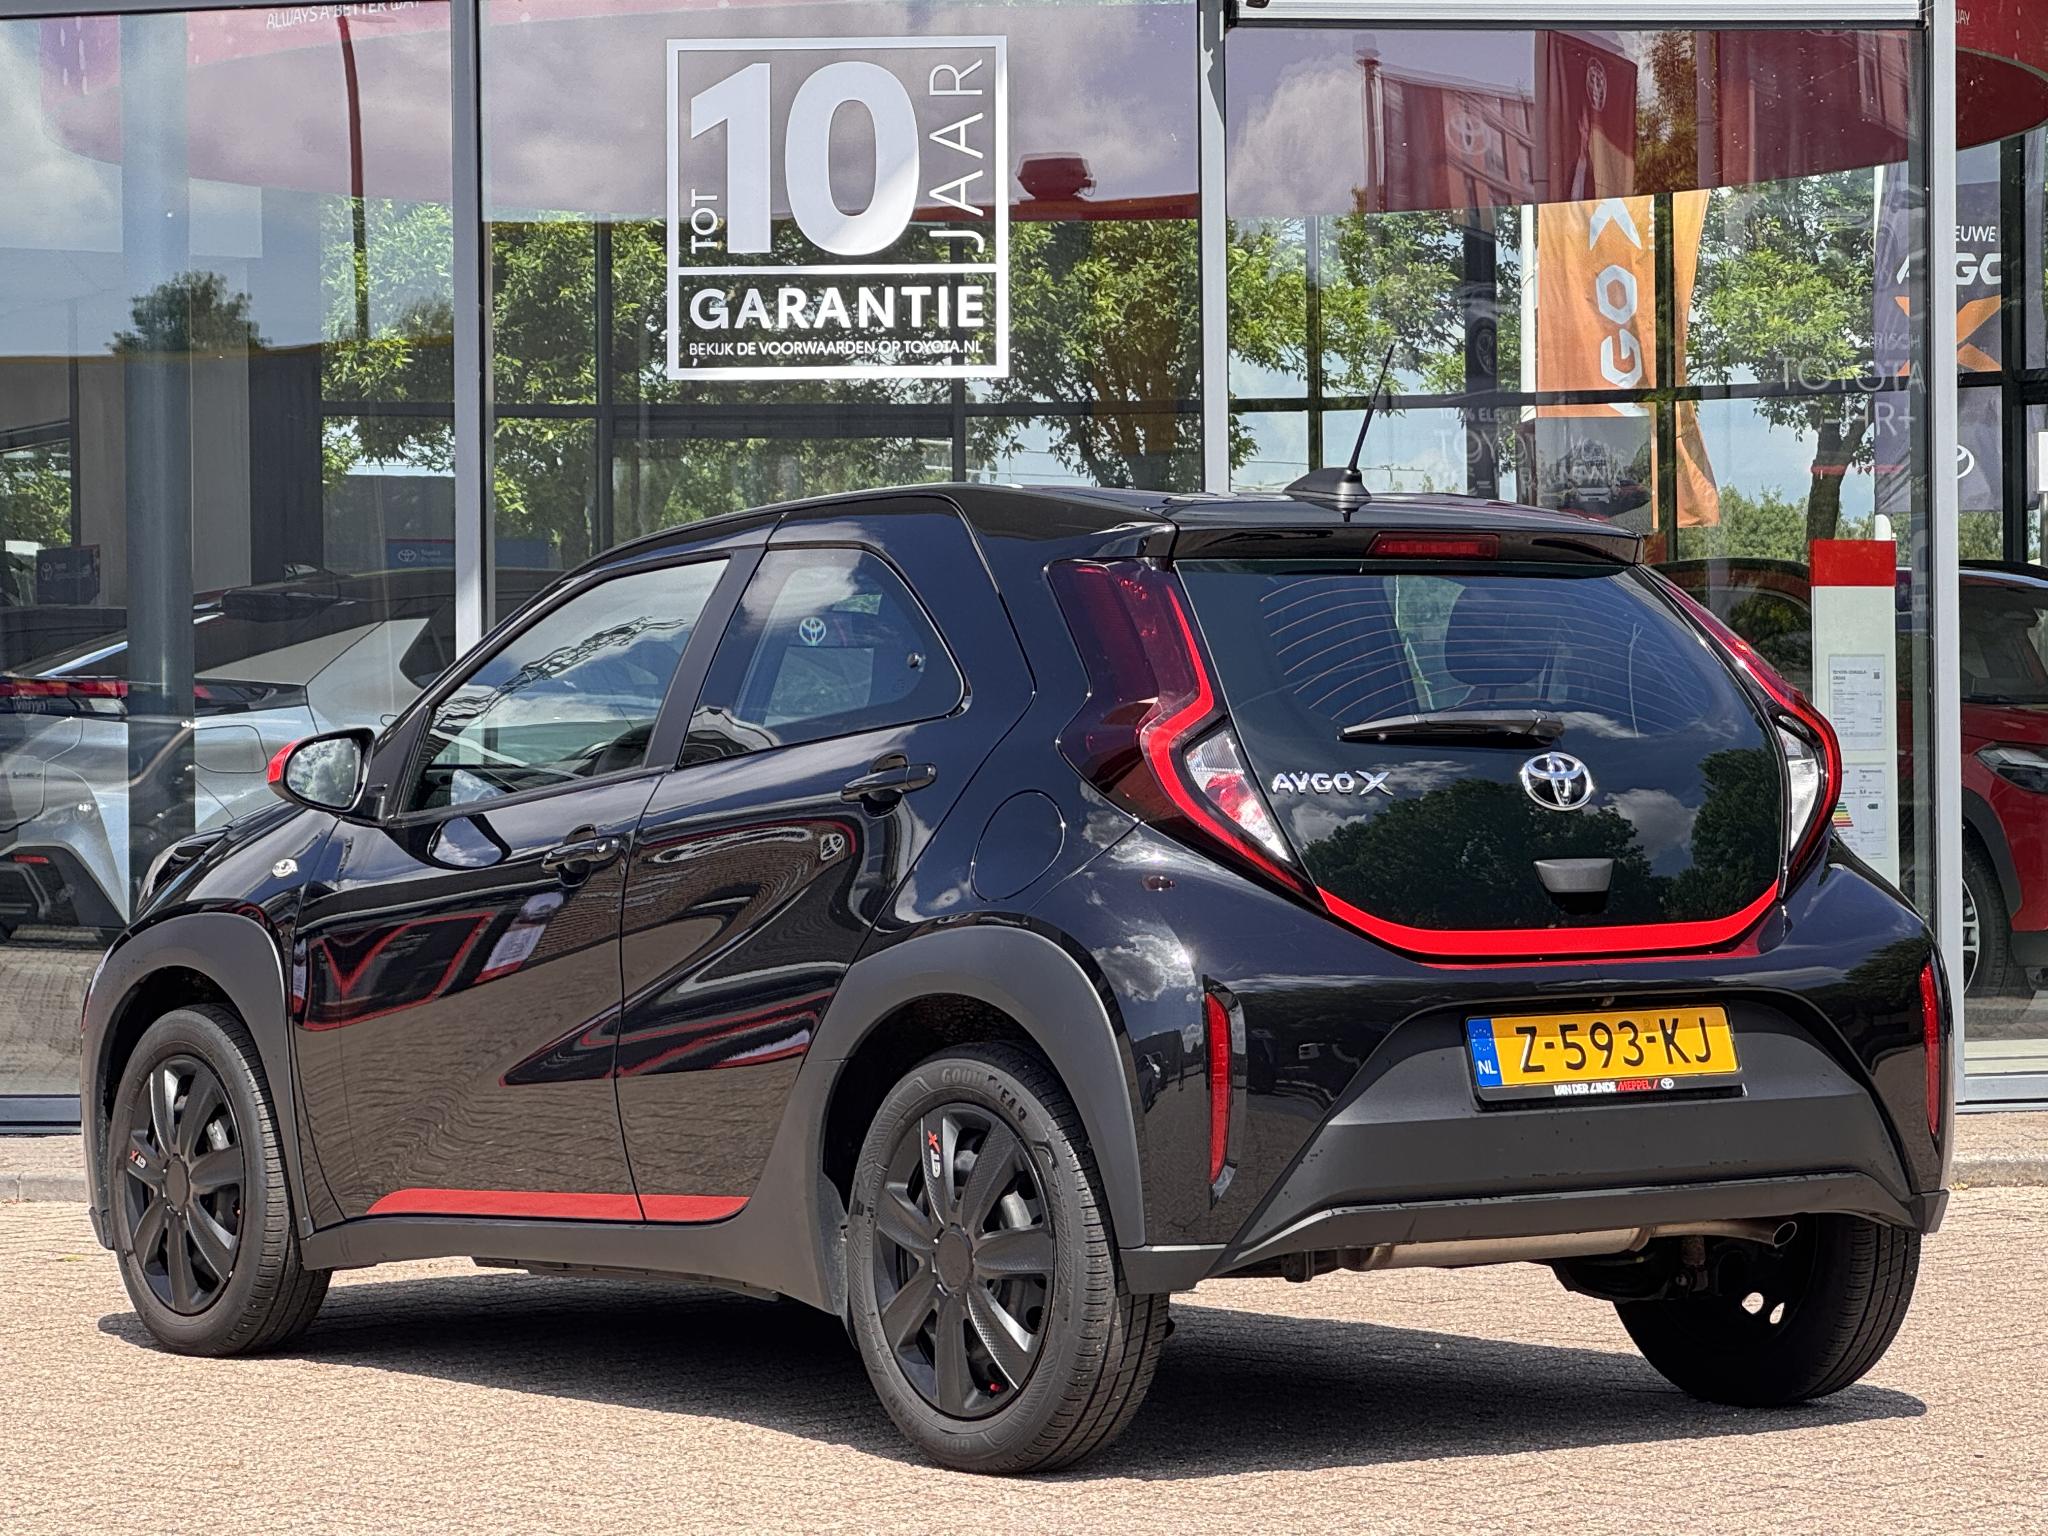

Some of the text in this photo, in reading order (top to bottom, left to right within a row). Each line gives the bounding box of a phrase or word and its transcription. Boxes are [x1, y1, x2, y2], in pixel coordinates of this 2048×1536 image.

[266, 7, 318, 30] ALWAYS
[319, 7, 331, 20] A
[690, 61, 920, 256] 10
[929, 58, 984, 253] JAAR
[691, 189, 718, 254] TOT
[689, 286, 984, 330] GARANTIE
[689, 339, 984, 356] BEKIJK DE VOORWAARDEN OP TOYOTA.NL
[1271, 772, 1355, 794] AYGO
[1515, 1017, 1713, 1073] Z-593-KJ
[1478, 1060, 1498, 1075] NL
[1554, 1084, 1572, 1096] VAN
[1572, 1083, 1589, 1095] DER
